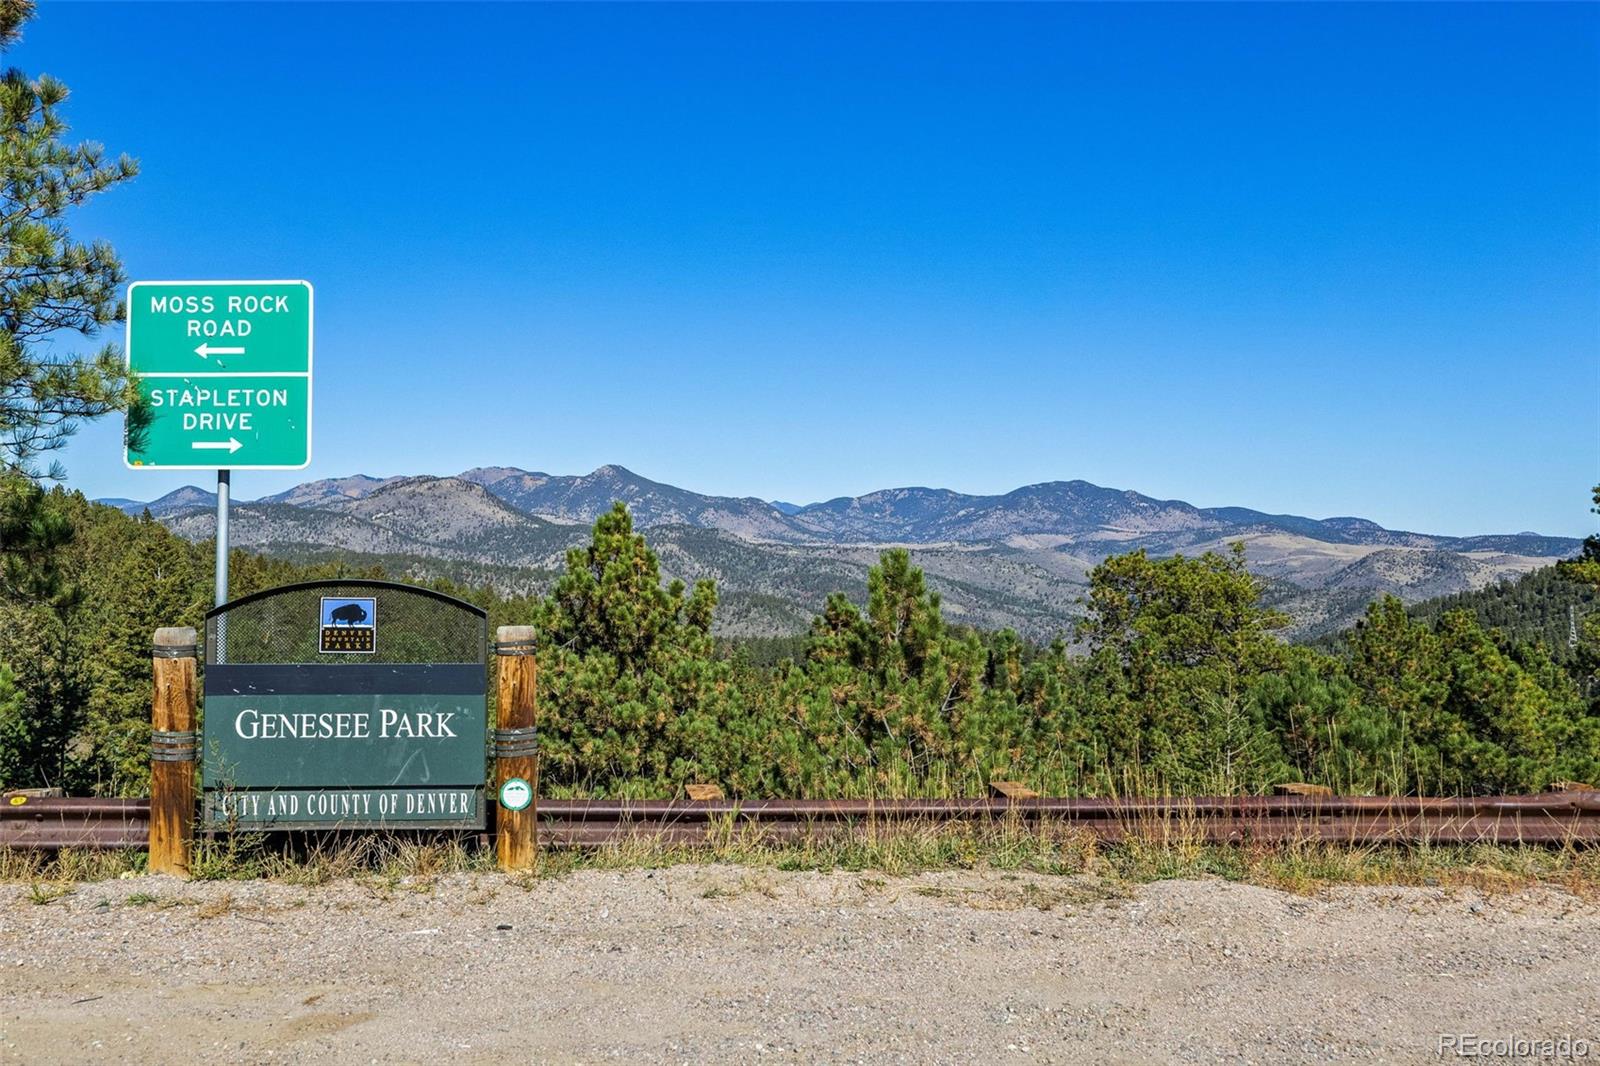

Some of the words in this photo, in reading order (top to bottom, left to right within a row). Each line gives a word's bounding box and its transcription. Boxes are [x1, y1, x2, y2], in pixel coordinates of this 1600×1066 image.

[151, 296, 215, 313] MOSS
[228, 296, 289, 313] ROCK
[187, 320, 252, 336] ROAD
[151, 389, 288, 406] STAPLETON
[183, 413, 253, 430] DRIVE
[235, 709, 370, 739] GENESEE
[379, 709, 458, 738] PARK
[268, 794, 299, 816] AND
[307, 794, 371, 815] COUNTY
[379, 793, 398, 814] OF
[406, 792, 469, 814] DENVER
